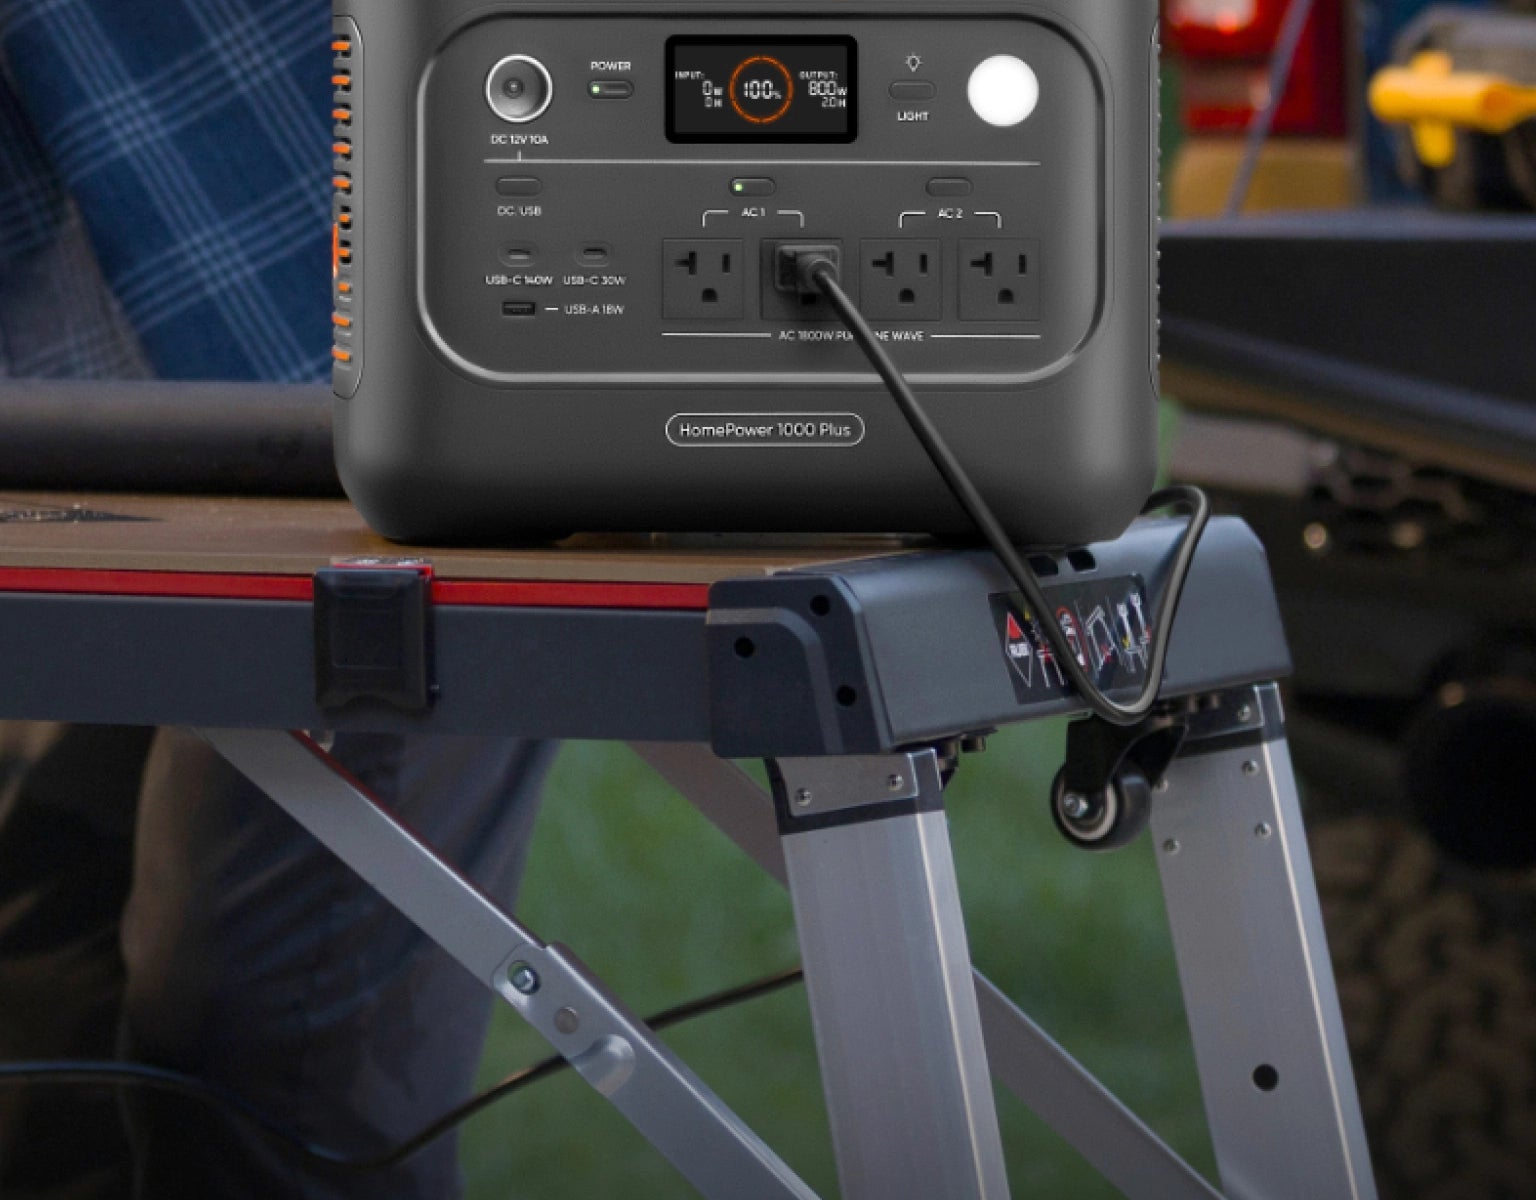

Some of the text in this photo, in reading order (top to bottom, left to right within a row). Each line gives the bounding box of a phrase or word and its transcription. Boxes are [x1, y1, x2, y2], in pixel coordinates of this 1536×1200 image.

[590, 61, 632, 71] POWER
[897, 111, 929, 121] LIGHT
[490, 134, 549, 145] DC 12V 10A
[519, 205, 542, 217] USB
[741, 207, 759, 217] AC
[937, 208, 963, 218] AC 2
[485, 275, 553, 285] USB-C 140W
[563, 275, 626, 285] USB-C 30W
[564, 304, 624, 315] USB-A 18W
[779, 330, 796, 341] AC
[891, 330, 925, 341] WAVE
[680, 423, 851, 438] HomePower 1000 Plus
